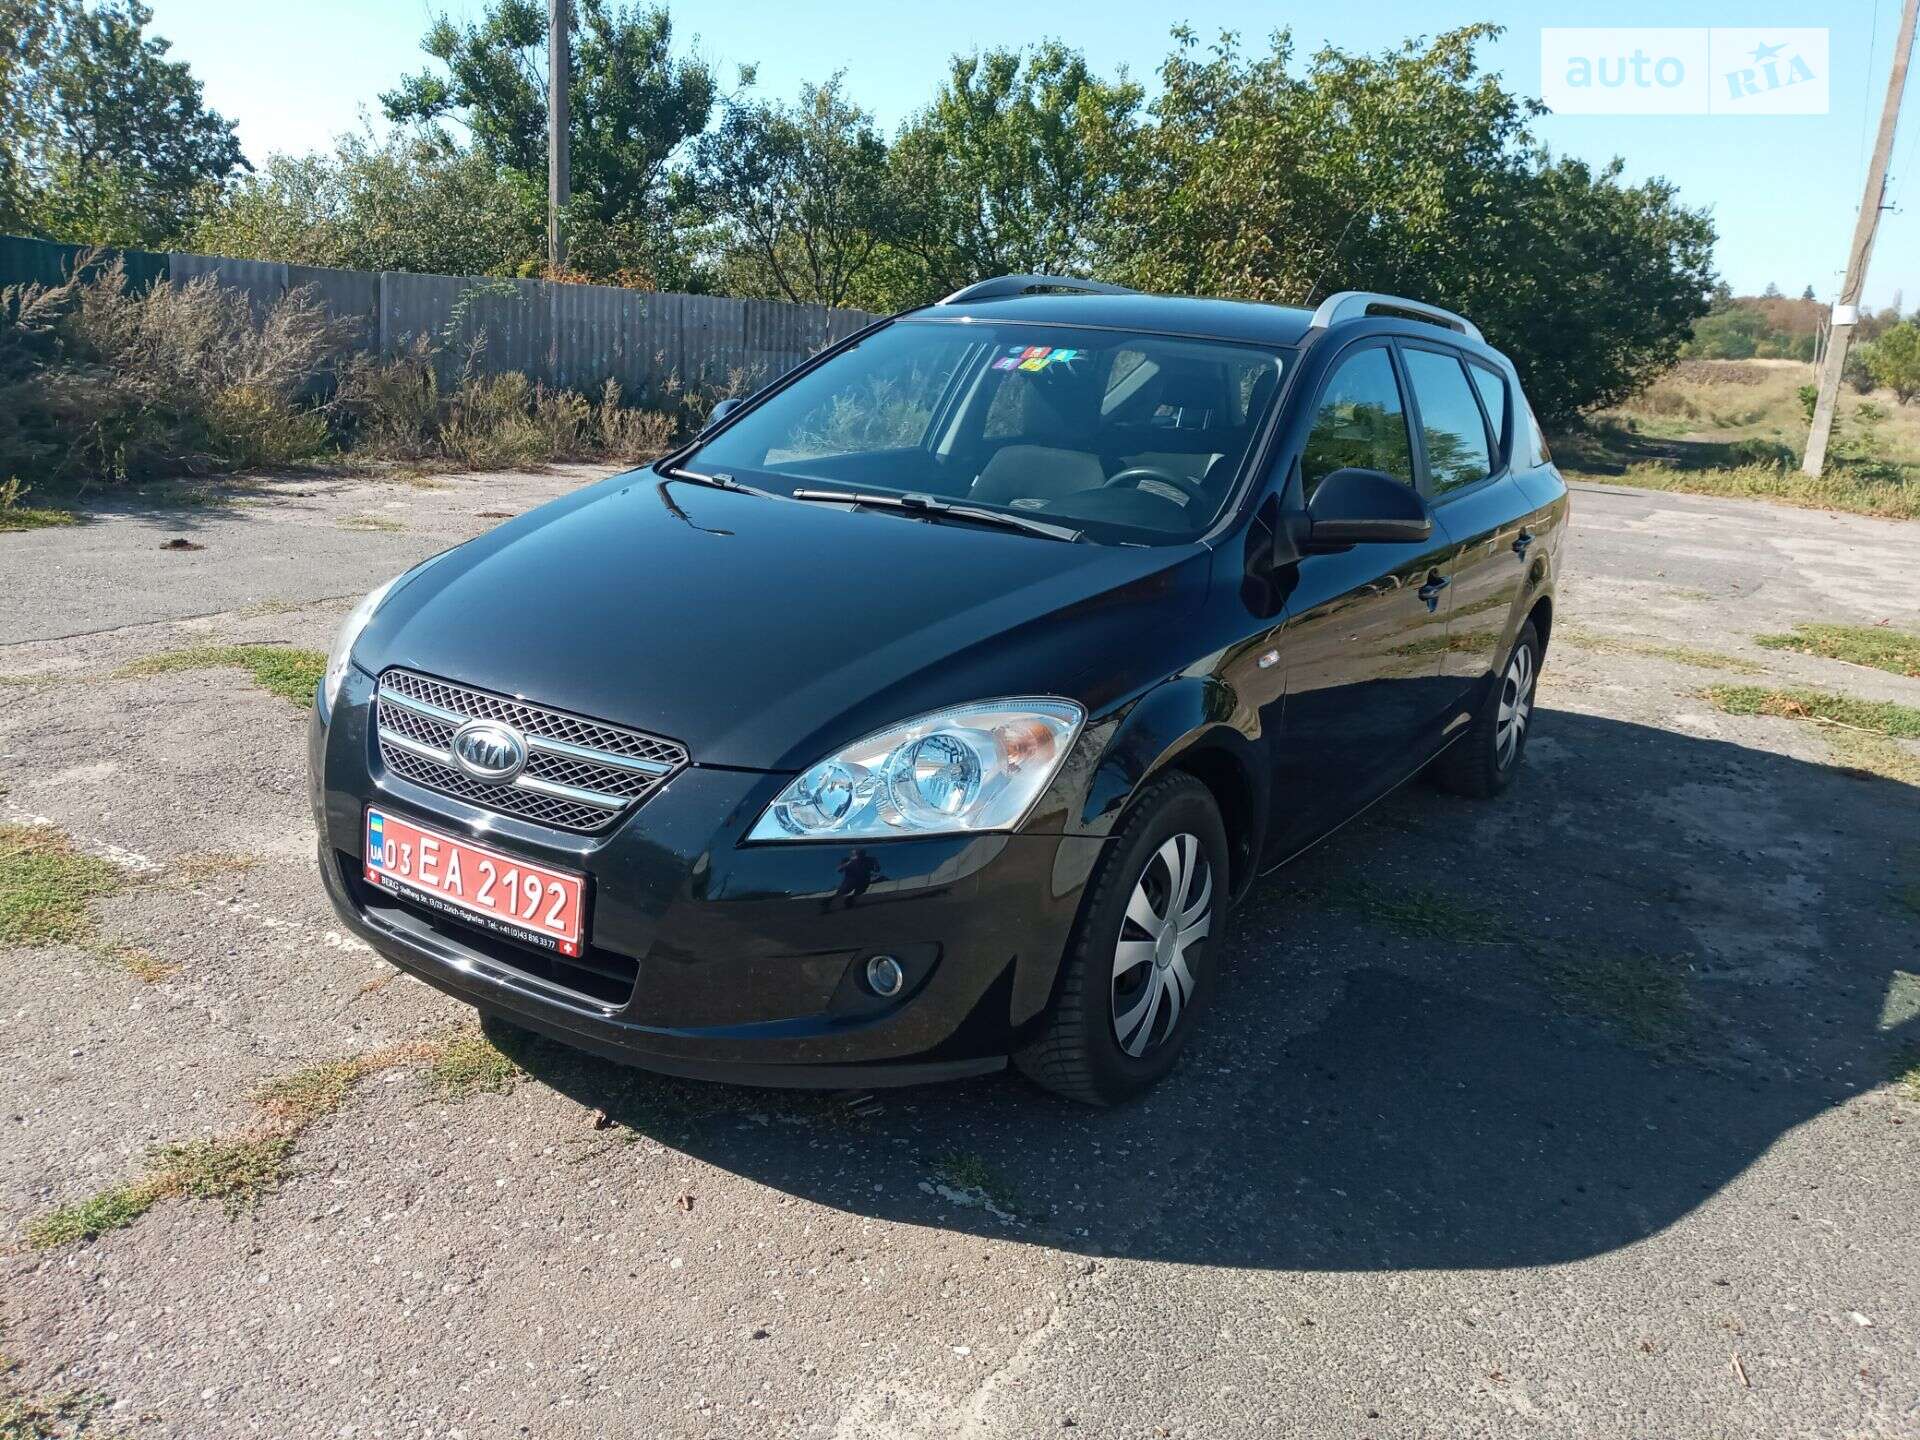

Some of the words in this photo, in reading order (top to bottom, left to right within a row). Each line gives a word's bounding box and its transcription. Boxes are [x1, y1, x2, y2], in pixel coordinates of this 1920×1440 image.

[370, 844, 383, 862] UA
[385, 838, 412, 875] 03
[419, 837, 464, 896] EA
[476, 859, 568, 930] 2192
